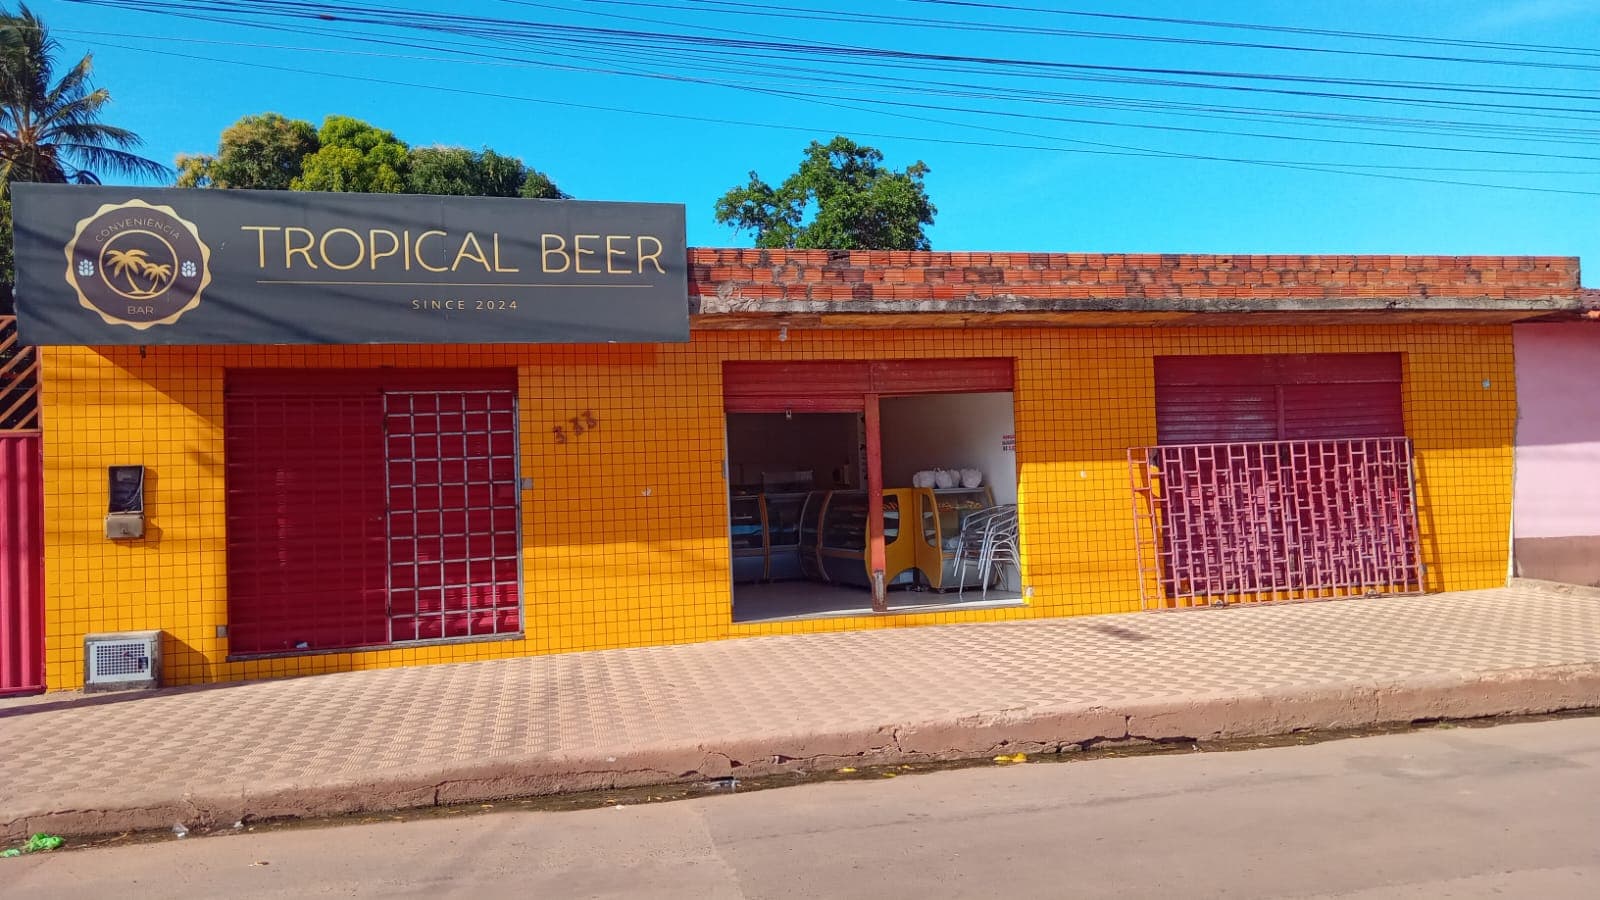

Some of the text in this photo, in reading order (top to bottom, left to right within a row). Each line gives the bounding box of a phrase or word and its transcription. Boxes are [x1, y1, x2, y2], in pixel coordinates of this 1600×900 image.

[240, 225, 666, 275] TROPICAL BEER
[127, 305, 154, 315] BAR
[412, 299, 518, 310] SINCE 2024
